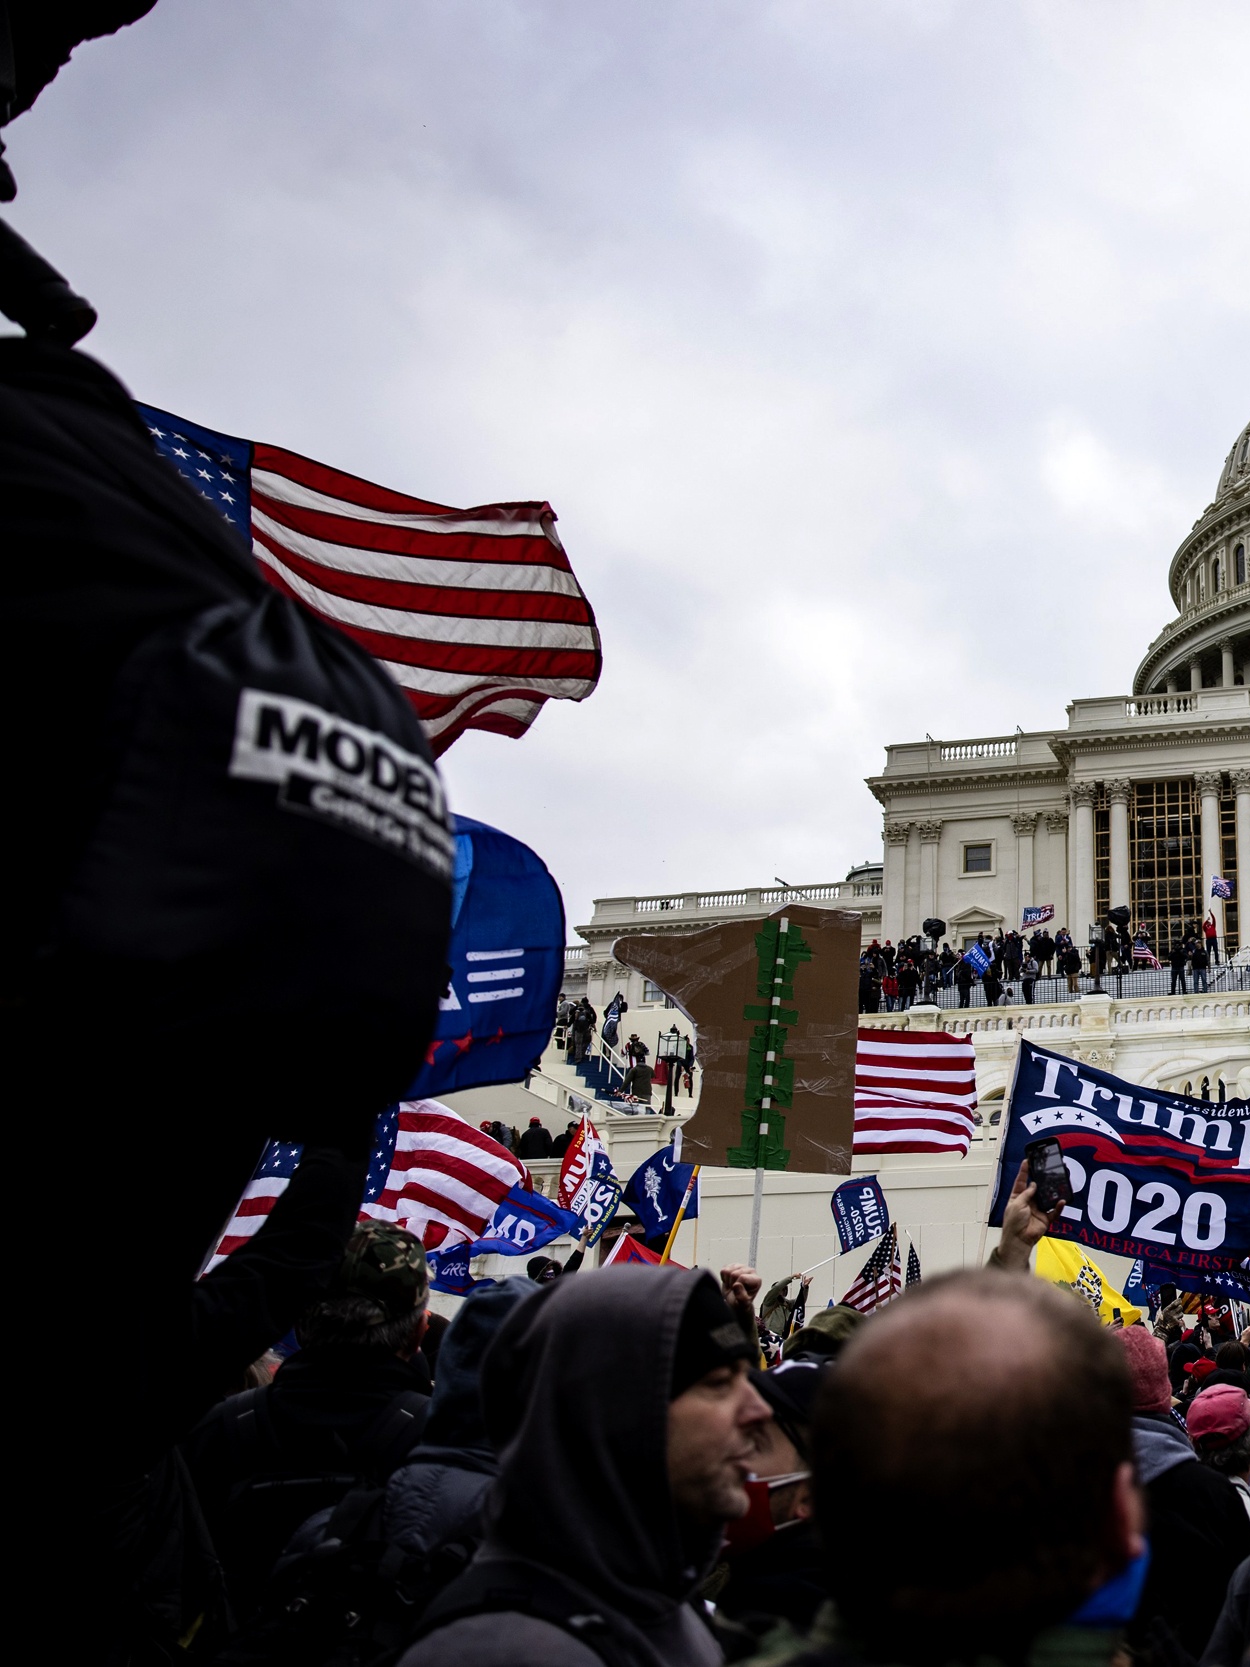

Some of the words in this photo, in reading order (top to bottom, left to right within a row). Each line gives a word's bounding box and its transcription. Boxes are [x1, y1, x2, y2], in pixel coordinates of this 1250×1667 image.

[1027, 910, 1052, 922] TRUMP
[1048, 1220, 1073, 1234] EP
[1078, 1227, 1172, 1262] AMERICA
[1177, 1251, 1237, 1270] FIRST
